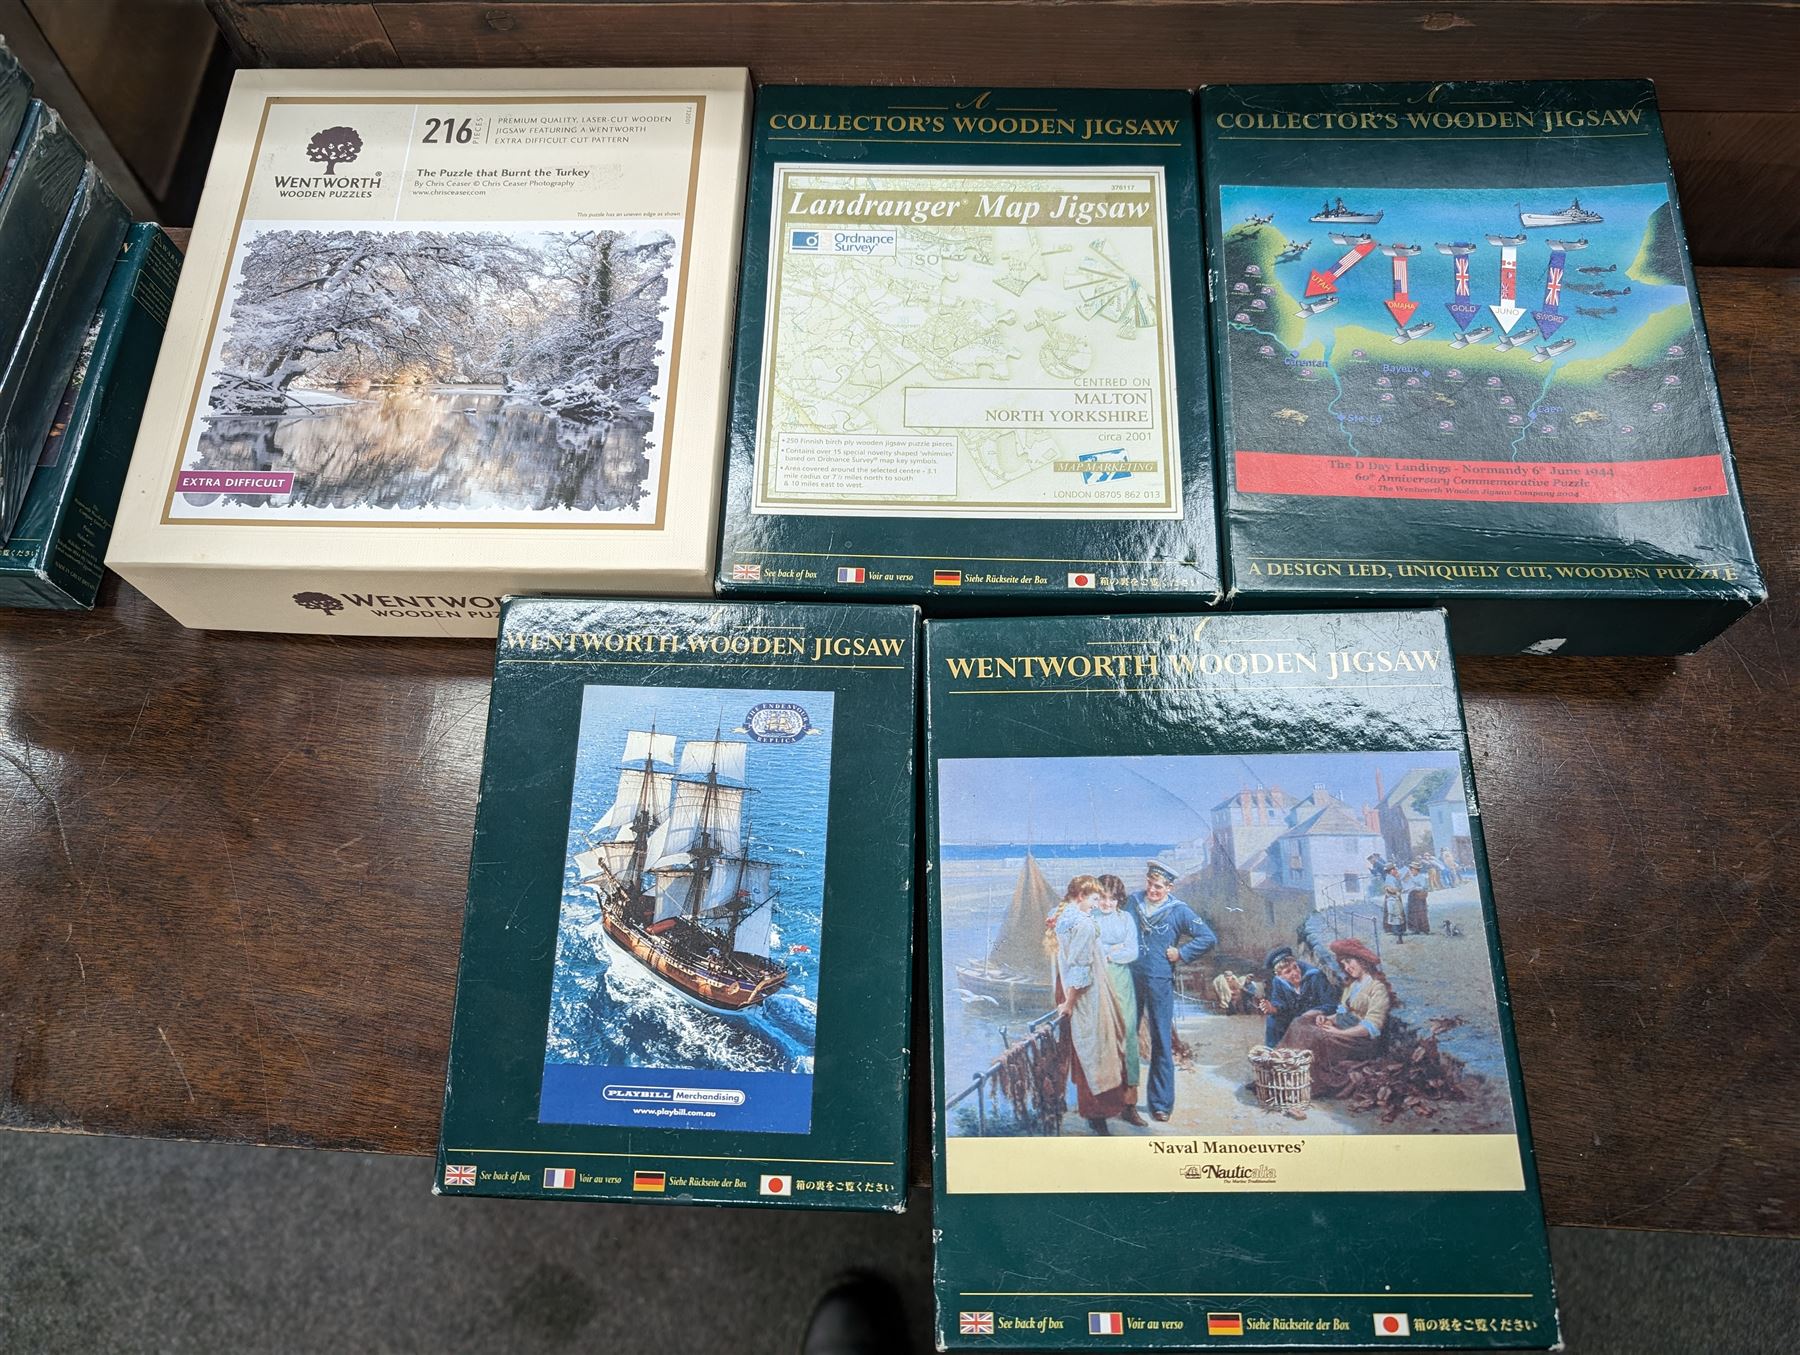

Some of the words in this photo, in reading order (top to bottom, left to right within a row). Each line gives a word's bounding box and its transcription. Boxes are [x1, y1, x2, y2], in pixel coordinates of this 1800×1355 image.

[497, 116, 538, 125] PREMIUM
[581, 115, 629, 124] LASER-CUT
[631, 115, 672, 123] WOODEN
[1216, 112, 1399, 130] COLLECTOR'S
[1406, 111, 1540, 129] WOODEN
[1542, 109, 1643, 132] JIGSAW
[422, 117, 473, 145] 216
[473, 116, 483, 145] PIECES
[495, 126, 527, 135] JIGSAW
[529, 126, 578, 135] FEATURING
[580, 126, 587, 134] A
[588, 126, 648, 134] WENTWORTH
[769, 113, 945, 133] COLLECTOR'S
[952, 117, 1076, 135] WOODEN
[1081, 119, 1179, 140] JIGSAW
[494, 137, 523, 145] EXTRA
[569, 136, 589, 144] CUT
[591, 136, 630, 144] PATTERN
[416, 168, 437, 178] The
[439, 168, 473, 178] Puzzle
[476, 168, 499, 178] that
[501, 168, 531, 178] Burnt
[533, 168, 552, 177] the
[555, 168, 590, 179] Turkey
[425, 180, 445, 188] Chris
[446, 180, 471, 188] Ceaser
[481, 180, 501, 188] Chris
[503, 180, 528, 188] Ceaser
[529, 180, 575, 189] Photography
[279, 190, 326, 199] WOODEN
[329, 190, 373, 199] PUZZLES
[412, 188, 487, 197] www.chrisceaser.com
[974, 195, 1040, 225] Map
[1049, 195, 1151, 225] Jigsaw
[834, 232, 894, 244] Ordnance
[1311, 274, 1332, 292] UTAH
[1388, 301, 1416, 310] OMAHA
[1451, 304, 1477, 313] GOLD
[1494, 307, 1519, 316] JUNO
[1535, 312, 1564, 323] SWORD
[1382, 364, 1420, 374] Bayeux
[1073, 378, 1127, 387] CENTRED
[1132, 378, 1151, 387] ON
[1074, 393, 1147, 405] MALTON
[1537, 405, 1562, 413] Caen
[985, 409, 1044, 422] NORTH
[1046, 410, 1149, 423] YORKSHIRE
[1098, 432, 1122, 441] circa
[1125, 432, 1151, 441] 2001
[885, 439, 906, 448] jigsaw
[908, 440, 930, 448] puzzle
[843, 449, 865, 457] special
[866, 449, 892, 457] novelty
[869, 466, 897, 474] selected
[1057, 463, 1081, 472] MAP
[1083, 463, 1153, 472] MARKETING
[1328, 460, 1350, 469] The
[1368, 461, 1392, 472] Day
[1394, 462, 1452, 474] Landings
[1462, 464, 1529, 477] Normandy
[1550, 466, 1580, 476] June
[1584, 466, 1615, 478] 1944
[182, 477, 221, 487] EXTRA
[225, 478, 286, 488] DIFFICULT
[1377, 475, 1451, 486] Anniversary
[1452, 476, 1550, 488] Commemorative
[1551, 479, 1590, 488] Puzzle
[1053, 491, 1093, 499] LONDON
[1094, 491, 1122, 499] 08705
[1123, 491, 1142, 499] 862
[1143, 491, 1161, 499] 013
[1395, 486, 1443, 494] Wentworth
[1445, 488, 1480, 496] Wooden
[1481, 489, 1512, 498] Jigsaw
[1513, 490, 1555, 499] Company
[764, 568, 777, 577] See
[777, 568, 795, 578] back
[795, 569, 805, 580] of
[805, 569, 818, 579] box
[868, 571, 884, 580] Voir
[895, 573, 914, 581] verso
[1247, 562, 1262, 575] A
[1266, 562, 1342, 576] DESIGN
[1348, 563, 1394, 580] LED,
[1397, 563, 1500, 582] UNIQUELY
[1506, 566, 1553, 581] CUT,
[1555, 566, 1651, 579] WOODEN
[1656, 567, 1738, 582] PUZZLE
[964, 574, 984, 583] Siehe
[985, 573, 1019, 584] Rückseite
[1020, 575, 1033, 584] der
[1034, 576, 1048, 585] Box
[371, 609, 462, 618] WOODEN
[506, 632, 680, 653] WENTWORTH
[687, 635, 807, 656] WOODEN
[811, 637, 906, 661] JIGSAW
[946, 655, 1159, 680] WENTWORTH
[1168, 652, 1318, 676] WOODEN
[1327, 650, 1441, 680] JIGSAW
[747, 706, 761, 721] THE
[762, 703, 809, 722] ENDEAVOUR
[607, 1088, 671, 1099] PLAYBILL
[675, 1091, 740, 1104] Merchandising
[633, 1107, 716, 1118] www.playbill.com.au
[1148, 1140, 1199, 1154] 'Naval
[1203, 1140, 1306, 1154] Manoeuvres'
[479, 1170, 492, 1180] See
[493, 1171, 510, 1181] back
[510, 1171, 519, 1184] of
[519, 1171, 531, 1182] box
[1202, 1164, 1277, 1180] Nauticalia
[579, 1173, 592, 1183] Voir
[604, 1176, 622, 1184] verso
[668, 1176, 688, 1186] Siehe
[688, 1176, 720, 1187] Rückseite
[721, 1178, 733, 1188] der
[734, 1179, 748, 1189] Box
[795, 1179, 895, 1192] 箱の裏をご覧ください
[998, 1316, 1014, 1329] See
[1014, 1317, 1039, 1330] back
[1039, 1317, 1050, 1334] of
[1049, 1317, 1065, 1330] box
[1126, 1317, 1145, 1330] Voir
[1147, 1320, 1159, 1330] au
[1161, 1320, 1184, 1330] verso
[1246, 1317, 1271, 1330] Siehe
[1272, 1317, 1314, 1331] Rückseite
[1315, 1318, 1331, 1331] der
[1332, 1318, 1350, 1331] Box
[1413, 1318, 1538, 1332] 箱の裏をご覧ください
